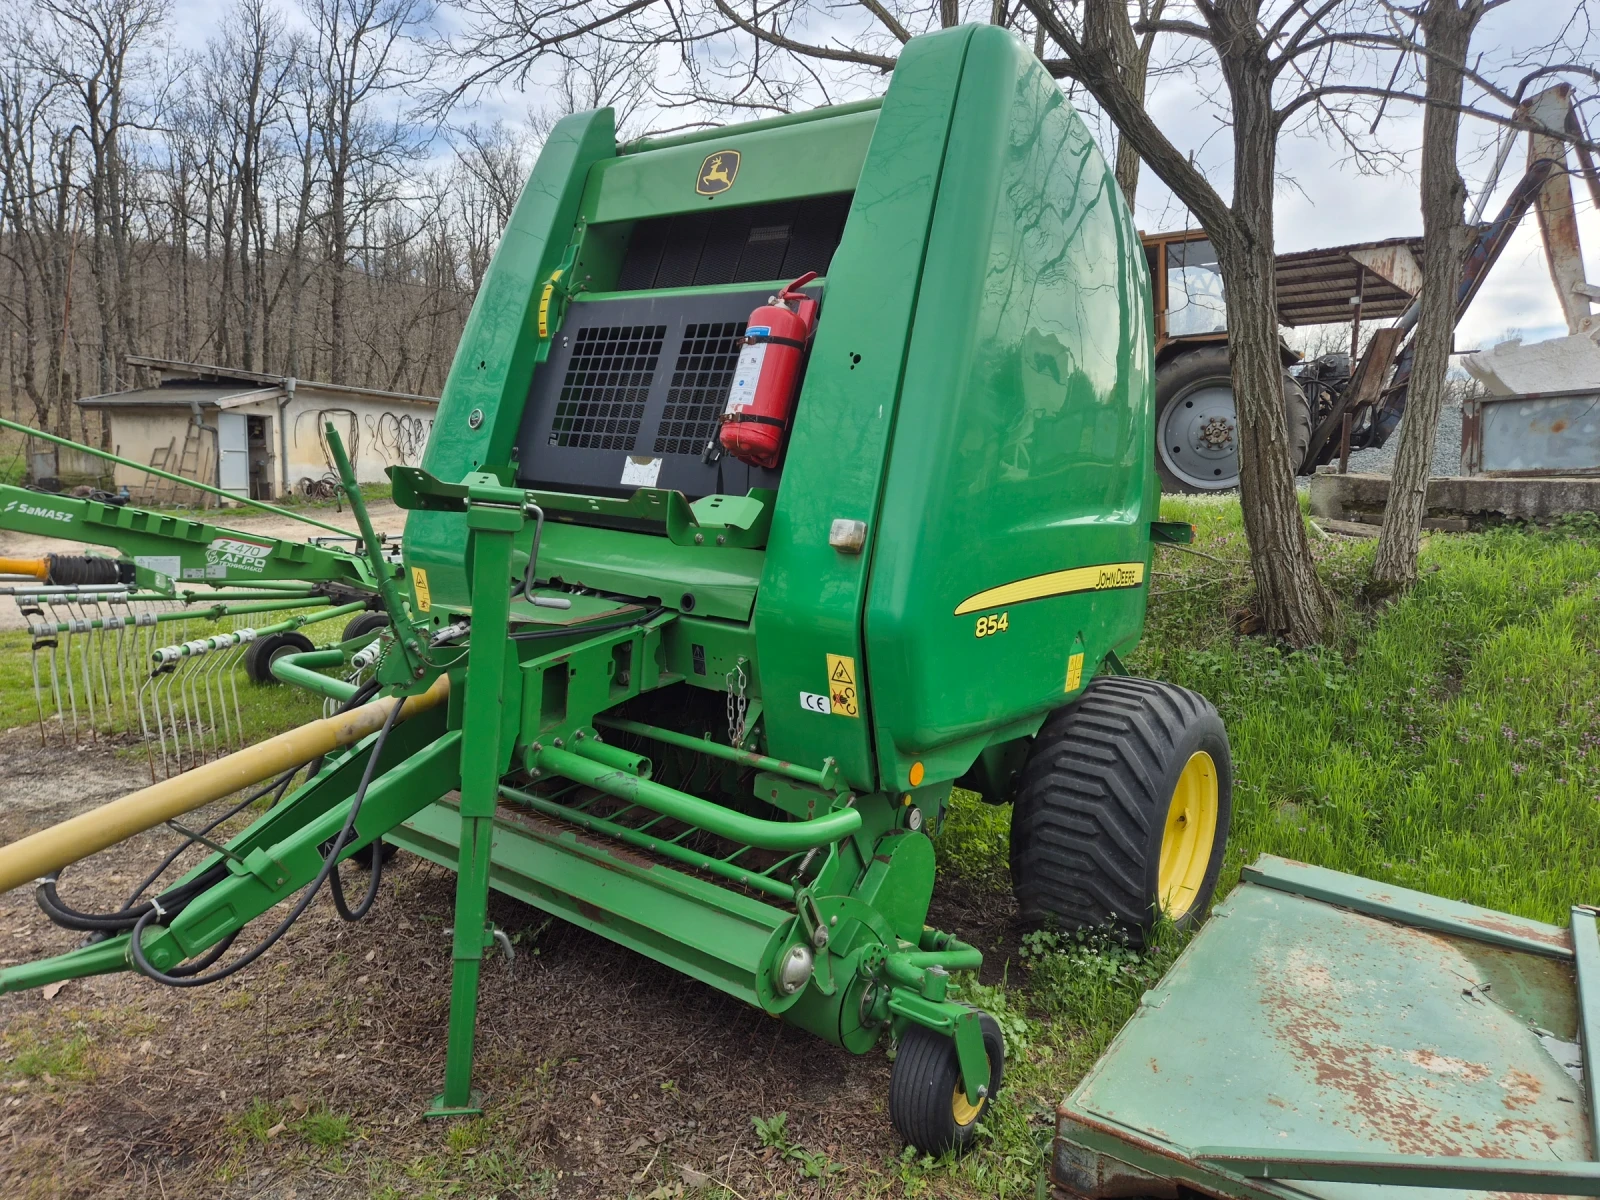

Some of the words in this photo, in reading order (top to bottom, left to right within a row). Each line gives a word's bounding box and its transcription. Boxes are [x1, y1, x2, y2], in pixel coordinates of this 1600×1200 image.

[18, 504, 74, 522] SaMASZ
[219, 541, 261, 557] Z-470
[220, 553, 266, 568] АГРО
[975, 611, 1009, 639] 854
